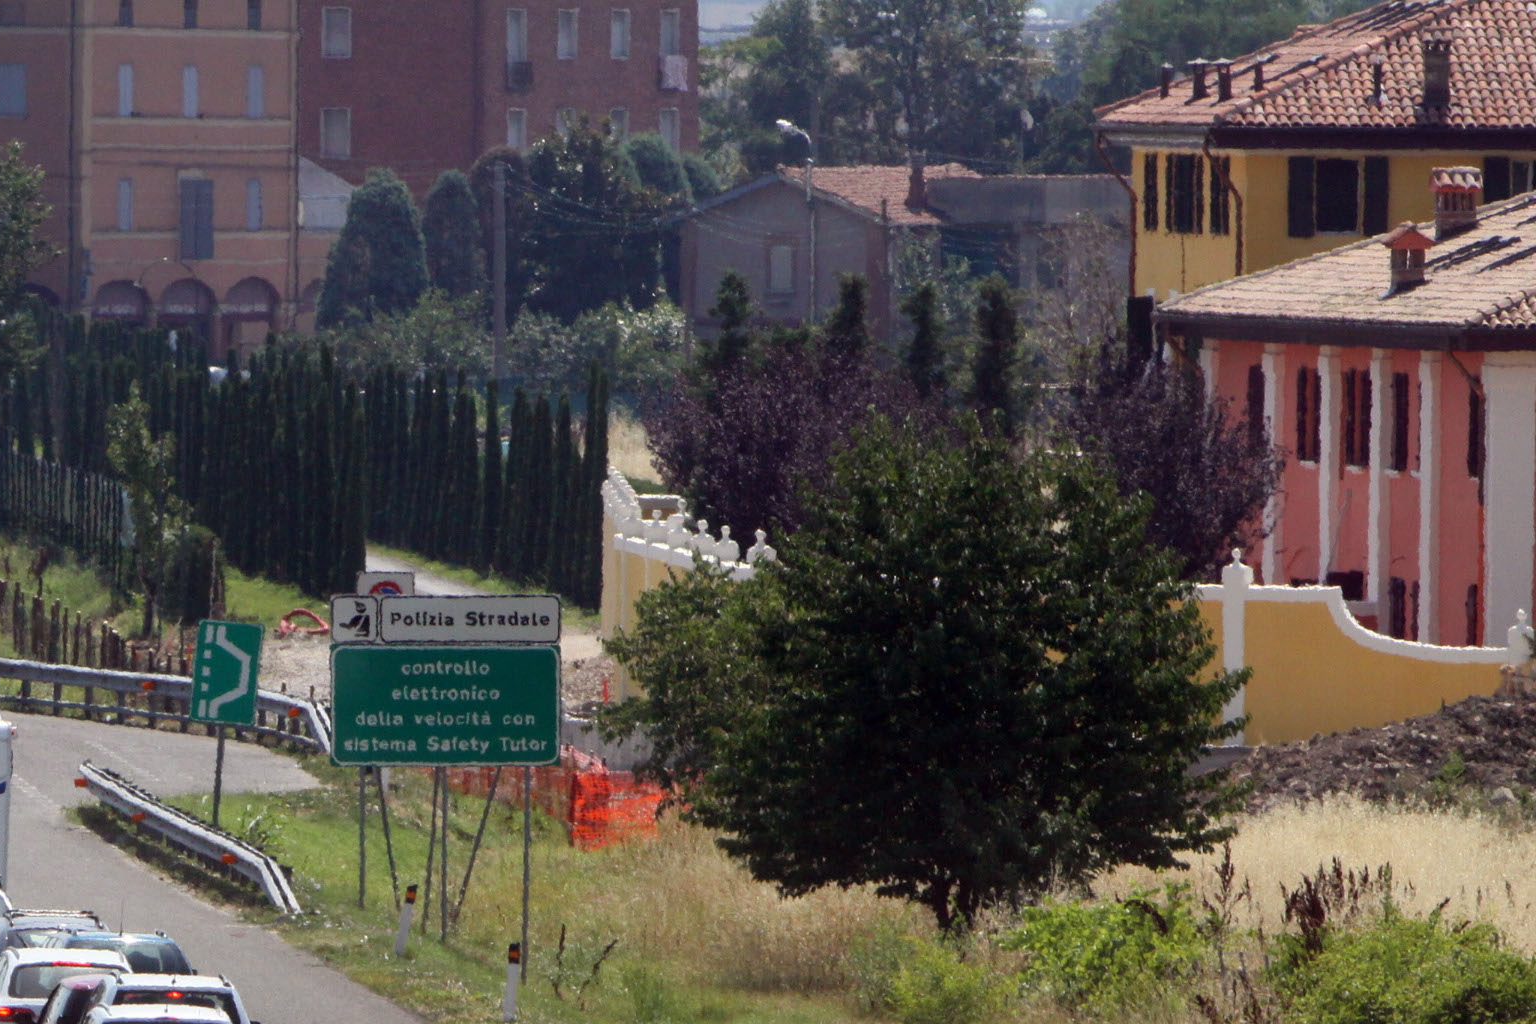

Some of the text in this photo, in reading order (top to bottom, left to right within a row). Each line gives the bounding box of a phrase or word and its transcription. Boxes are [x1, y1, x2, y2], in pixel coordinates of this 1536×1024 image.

[390, 611, 551, 627] Polizia Stradale
[401, 659, 491, 675] controllo
[391, 686, 501, 701] elettronico
[355, 711, 536, 726] della velocità con
[343, 735, 548, 754] sistema Safety Tutor
